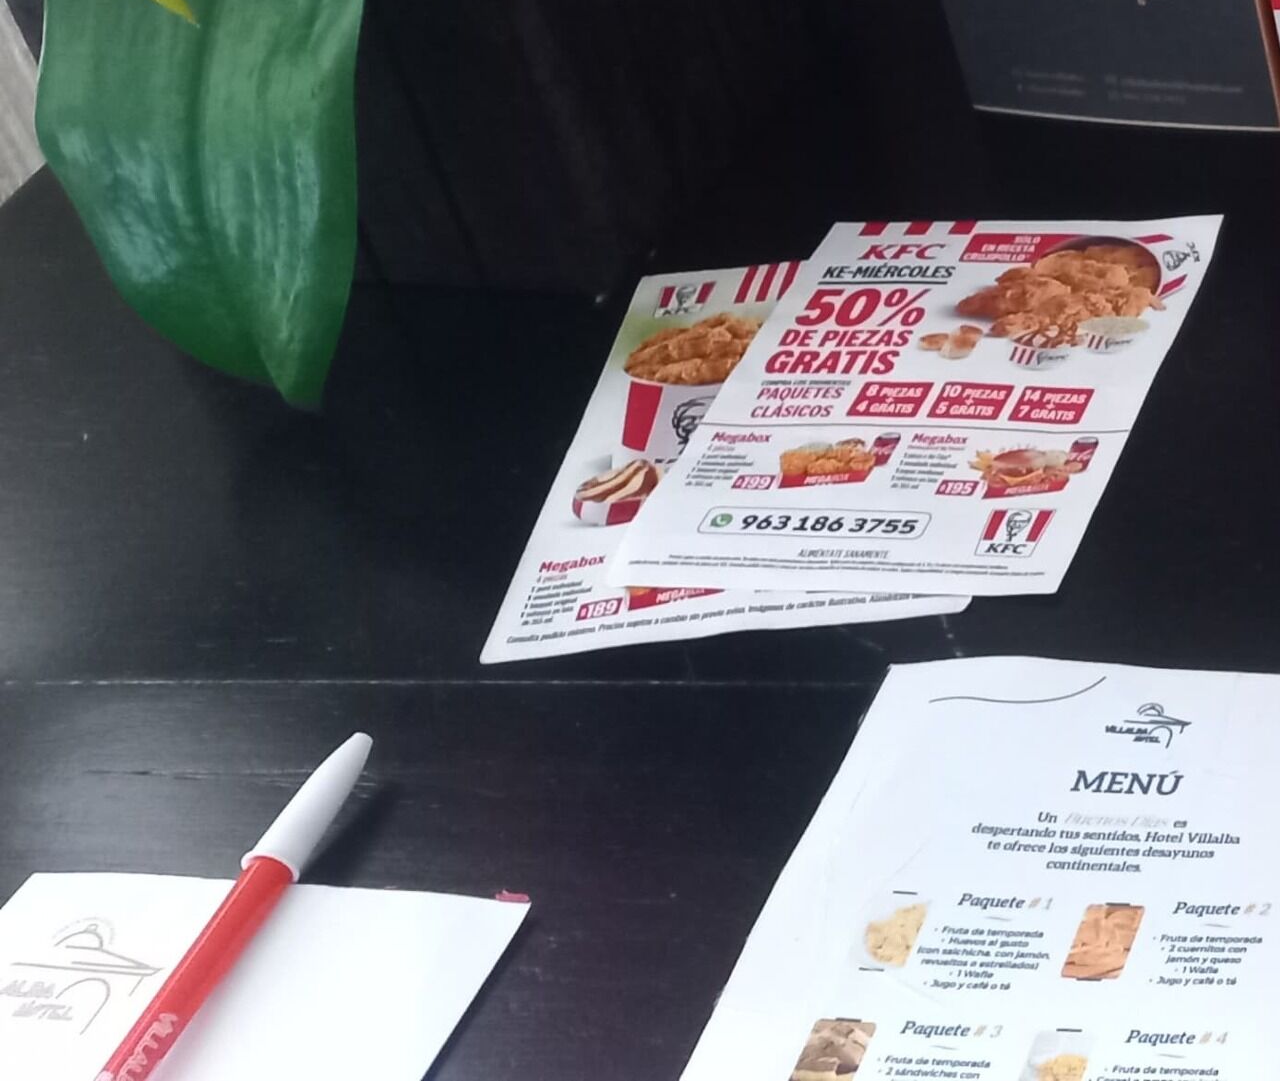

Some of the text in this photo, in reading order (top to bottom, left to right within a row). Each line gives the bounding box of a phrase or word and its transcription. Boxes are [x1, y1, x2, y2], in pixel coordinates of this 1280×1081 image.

[857, 243, 946, 261] KFC
[822, 262, 957, 280] KE-MIÉRCOLES
[794, 288, 932, 328] 50%
[778, 329, 914, 347] DE PIEZAS
[764, 350, 901, 375] GRATIS
[756, 386, 845, 402] PAQUETES
[866, 384, 924, 399] 8 PIEZAS
[942, 384, 1006, 401] 10 PIEZAS
[1024, 389, 1088, 405] 14 PIEZAS
[750, 403, 834, 418] CLÁSICOS
[856, 402, 915, 414] 4 GRATIS
[935, 402, 994, 417] 5 GRATIS
[1017, 405, 1076, 422] 7 GRATIS
[711, 431, 773, 445] Megabox
[911, 432, 968, 445] Megabox
[740, 514, 918, 534] 963 186 3755
[984, 542, 1028, 555] KFC
[539, 554, 607, 573] Megabox
[1070, 770, 1184, 796] MENÚ
[1037, 811, 1188, 829] Un es
[971, 822, 1057, 840] despertando
[1059, 829, 1080, 840] tus
[1144, 831, 1183, 844] Hotel
[1187, 832, 1241, 845] Villalba
[987, 839, 1215, 861] te ofrece los siguientes desayunos
[1046, 858, 1143, 873] continentales.
[957, 892, 1026, 910] Paquete
[1172, 901, 1273, 918] Paquete 2
[941, 925, 1044, 939] Fruta de temporada
[1159, 934, 1263, 945] Fruta de temporada
[948, 937, 1030, 948] Huevos al gusto
[1168, 944, 1176, 953] 2
[1227, 946, 1248, 954] con
[994, 950, 1014, 958] con
[1165, 954, 1242, 965] jamón y queso
[920, 957, 1040, 971] revueltos estrellados)
[930, 979, 1011, 991] Jugo y café o té
[1156, 976, 1238, 987] Jugo y café o té
[900, 1020, 1004, 1039] Paquete 3
[1125, 1029, 1229, 1046] Paquete 4
[884, 1055, 991, 1069] Fruta de temporada
[885, 1066, 894, 1076] 2
[959, 1071, 981, 1080] con
[1112, 1064, 1220, 1076] Fruta de temporada
